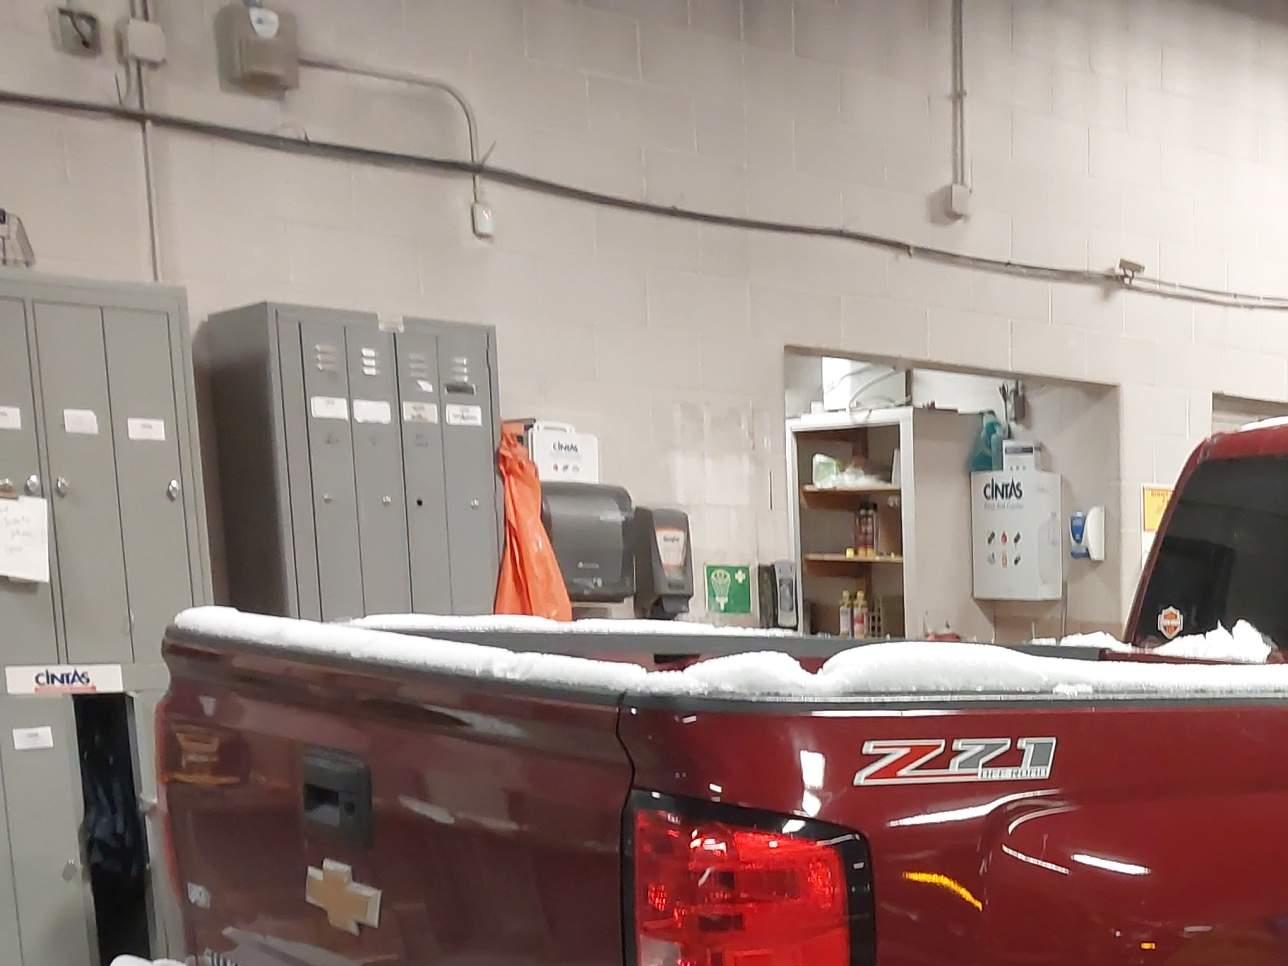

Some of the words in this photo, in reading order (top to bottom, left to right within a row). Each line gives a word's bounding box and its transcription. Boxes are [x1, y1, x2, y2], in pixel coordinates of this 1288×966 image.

[983, 476, 1023, 500] CINTAS
[34, 668, 91, 685] CINTAS
[854, 737, 1056, 786] Z71
